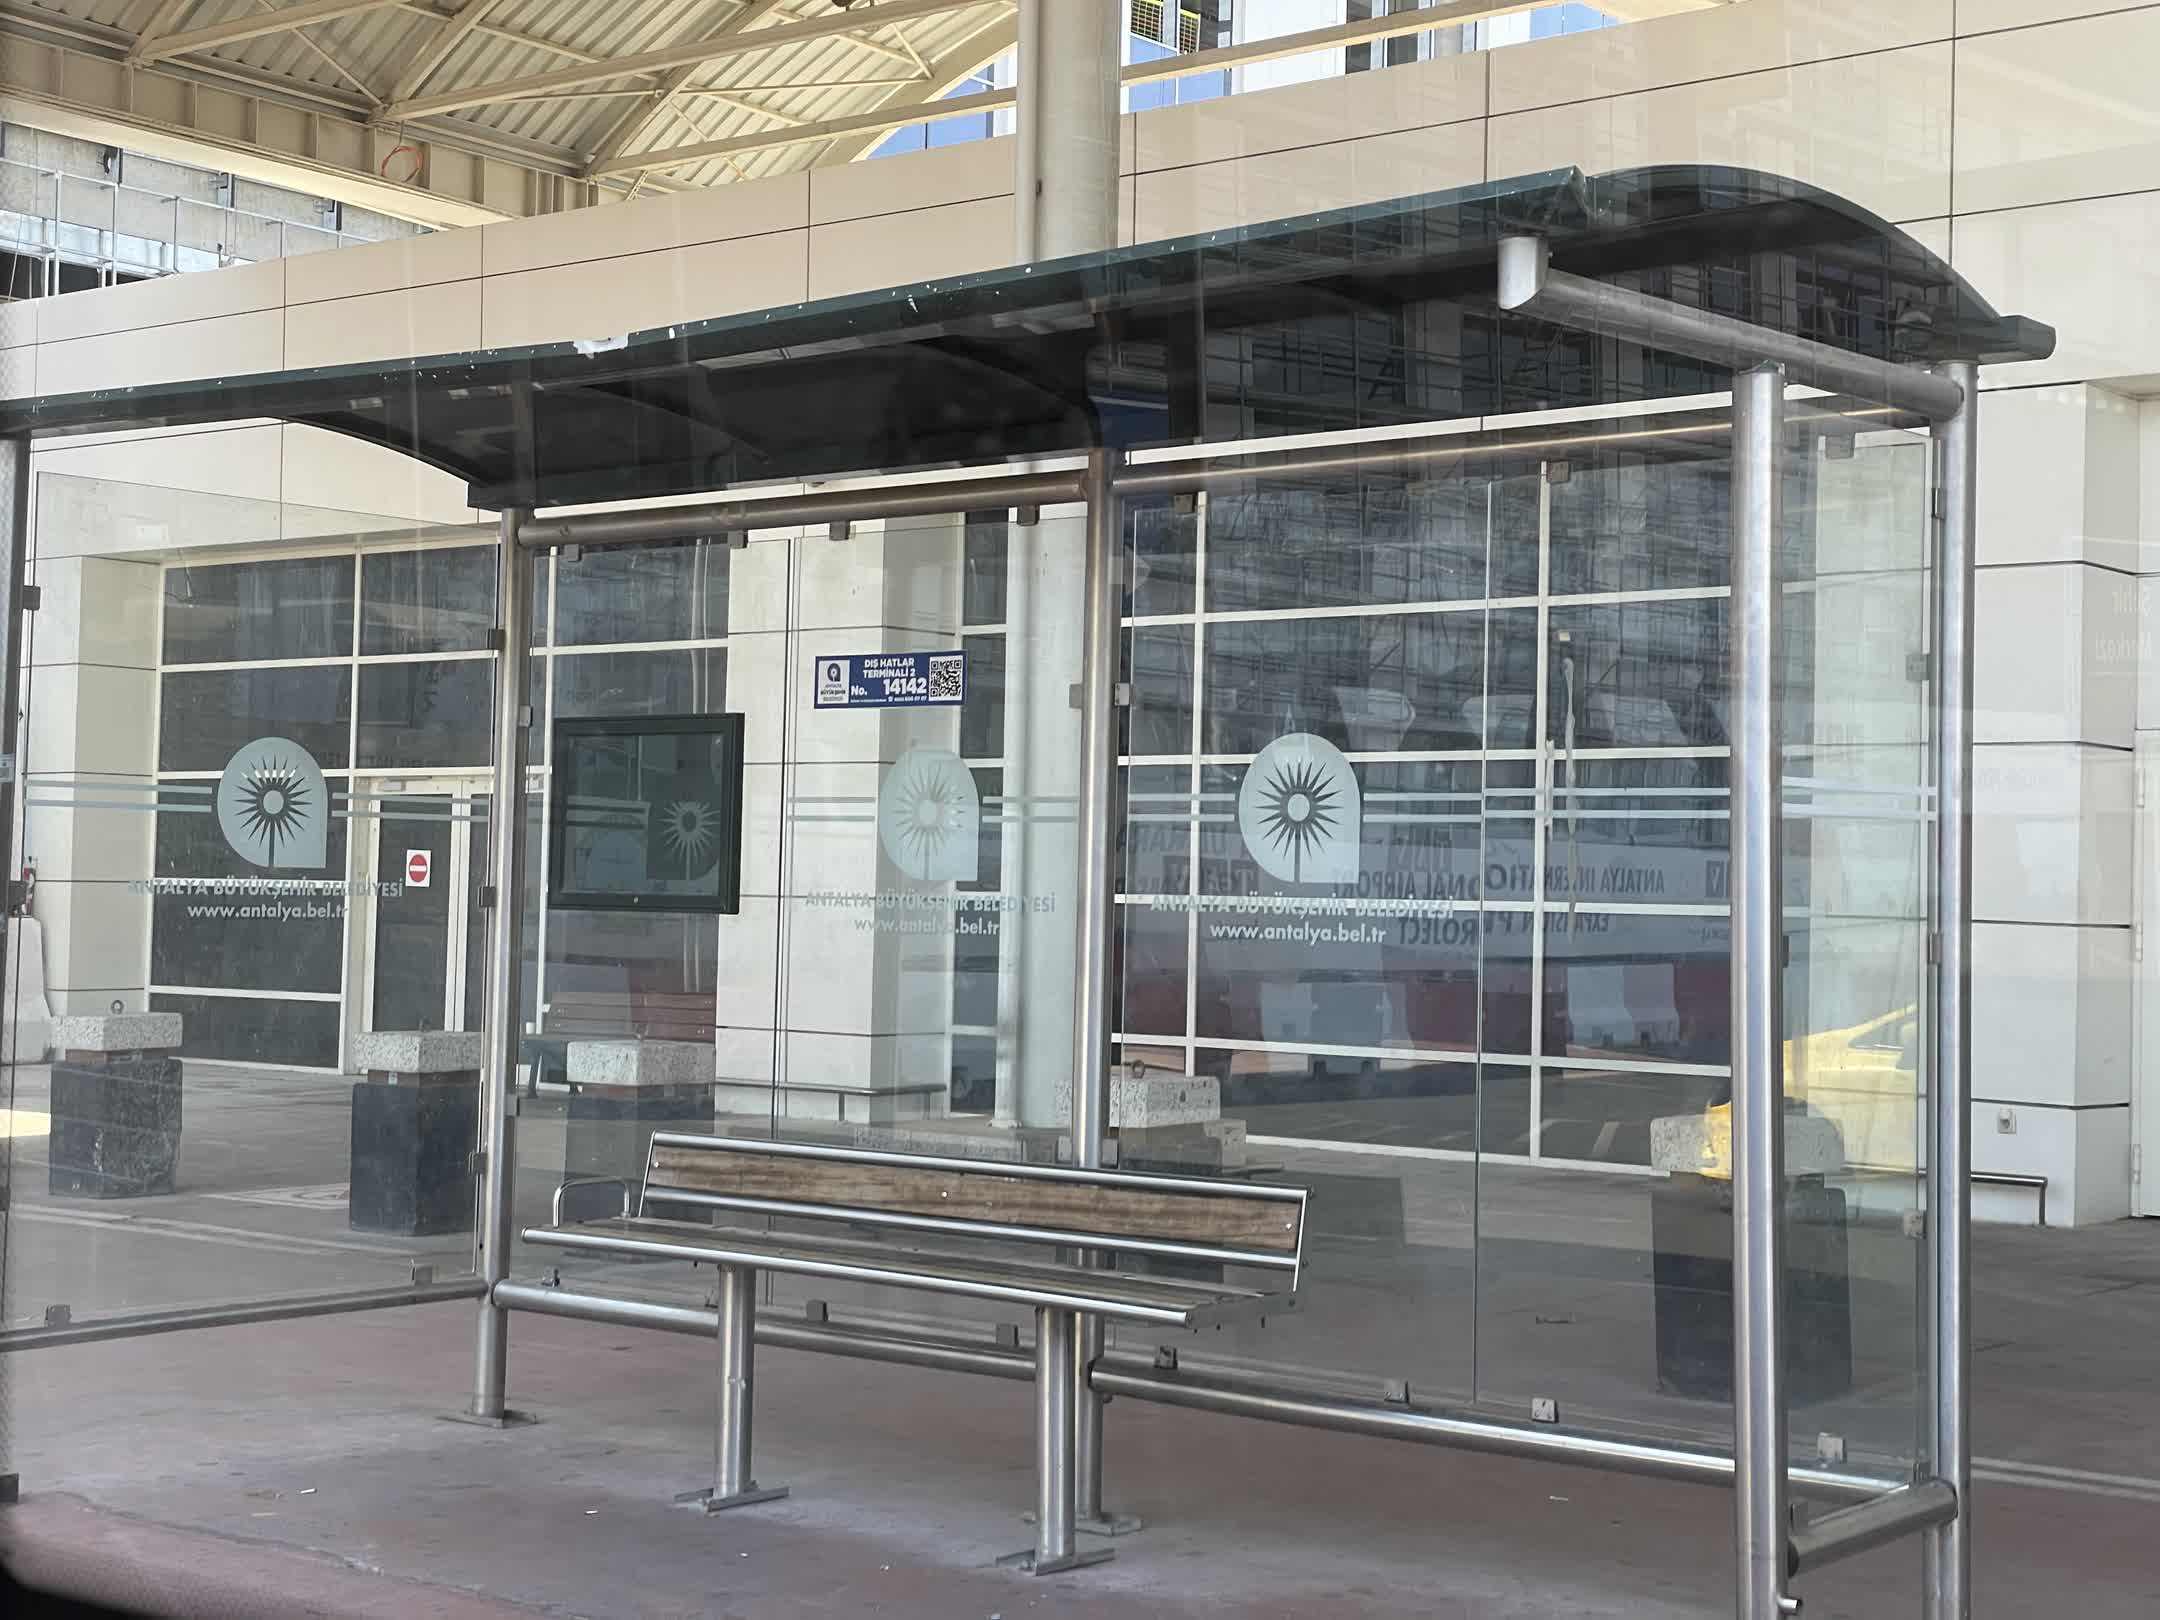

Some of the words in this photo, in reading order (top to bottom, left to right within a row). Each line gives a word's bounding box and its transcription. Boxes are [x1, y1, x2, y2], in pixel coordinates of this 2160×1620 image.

[863, 666, 909, 679] TERMİNALİ
[909, 667, 917, 678] 2
[864, 658, 879, 670] DIŞ
[880, 657, 915, 668] HATLAR
[850, 685, 868, 697] No.
[883, 677, 928, 696] 14142
[128, 879, 209, 897] ANTALYA
[213, 875, 317, 900] BÜYÜKŞEHİR
[322, 877, 404, 898] BELEDİYESİ
[804, 891, 872, 911] ANTALYA
[1150, 895, 1231, 913] ANTALYA
[1235, 891, 1349, 919] BÜYÜKŞEHİR
[1354, 894, 1455, 920] BELEDİYESİ
[187, 901, 348, 922] www.antalya.bel.tr
[1209, 921, 1388, 946] www.antalya.bel.tr
